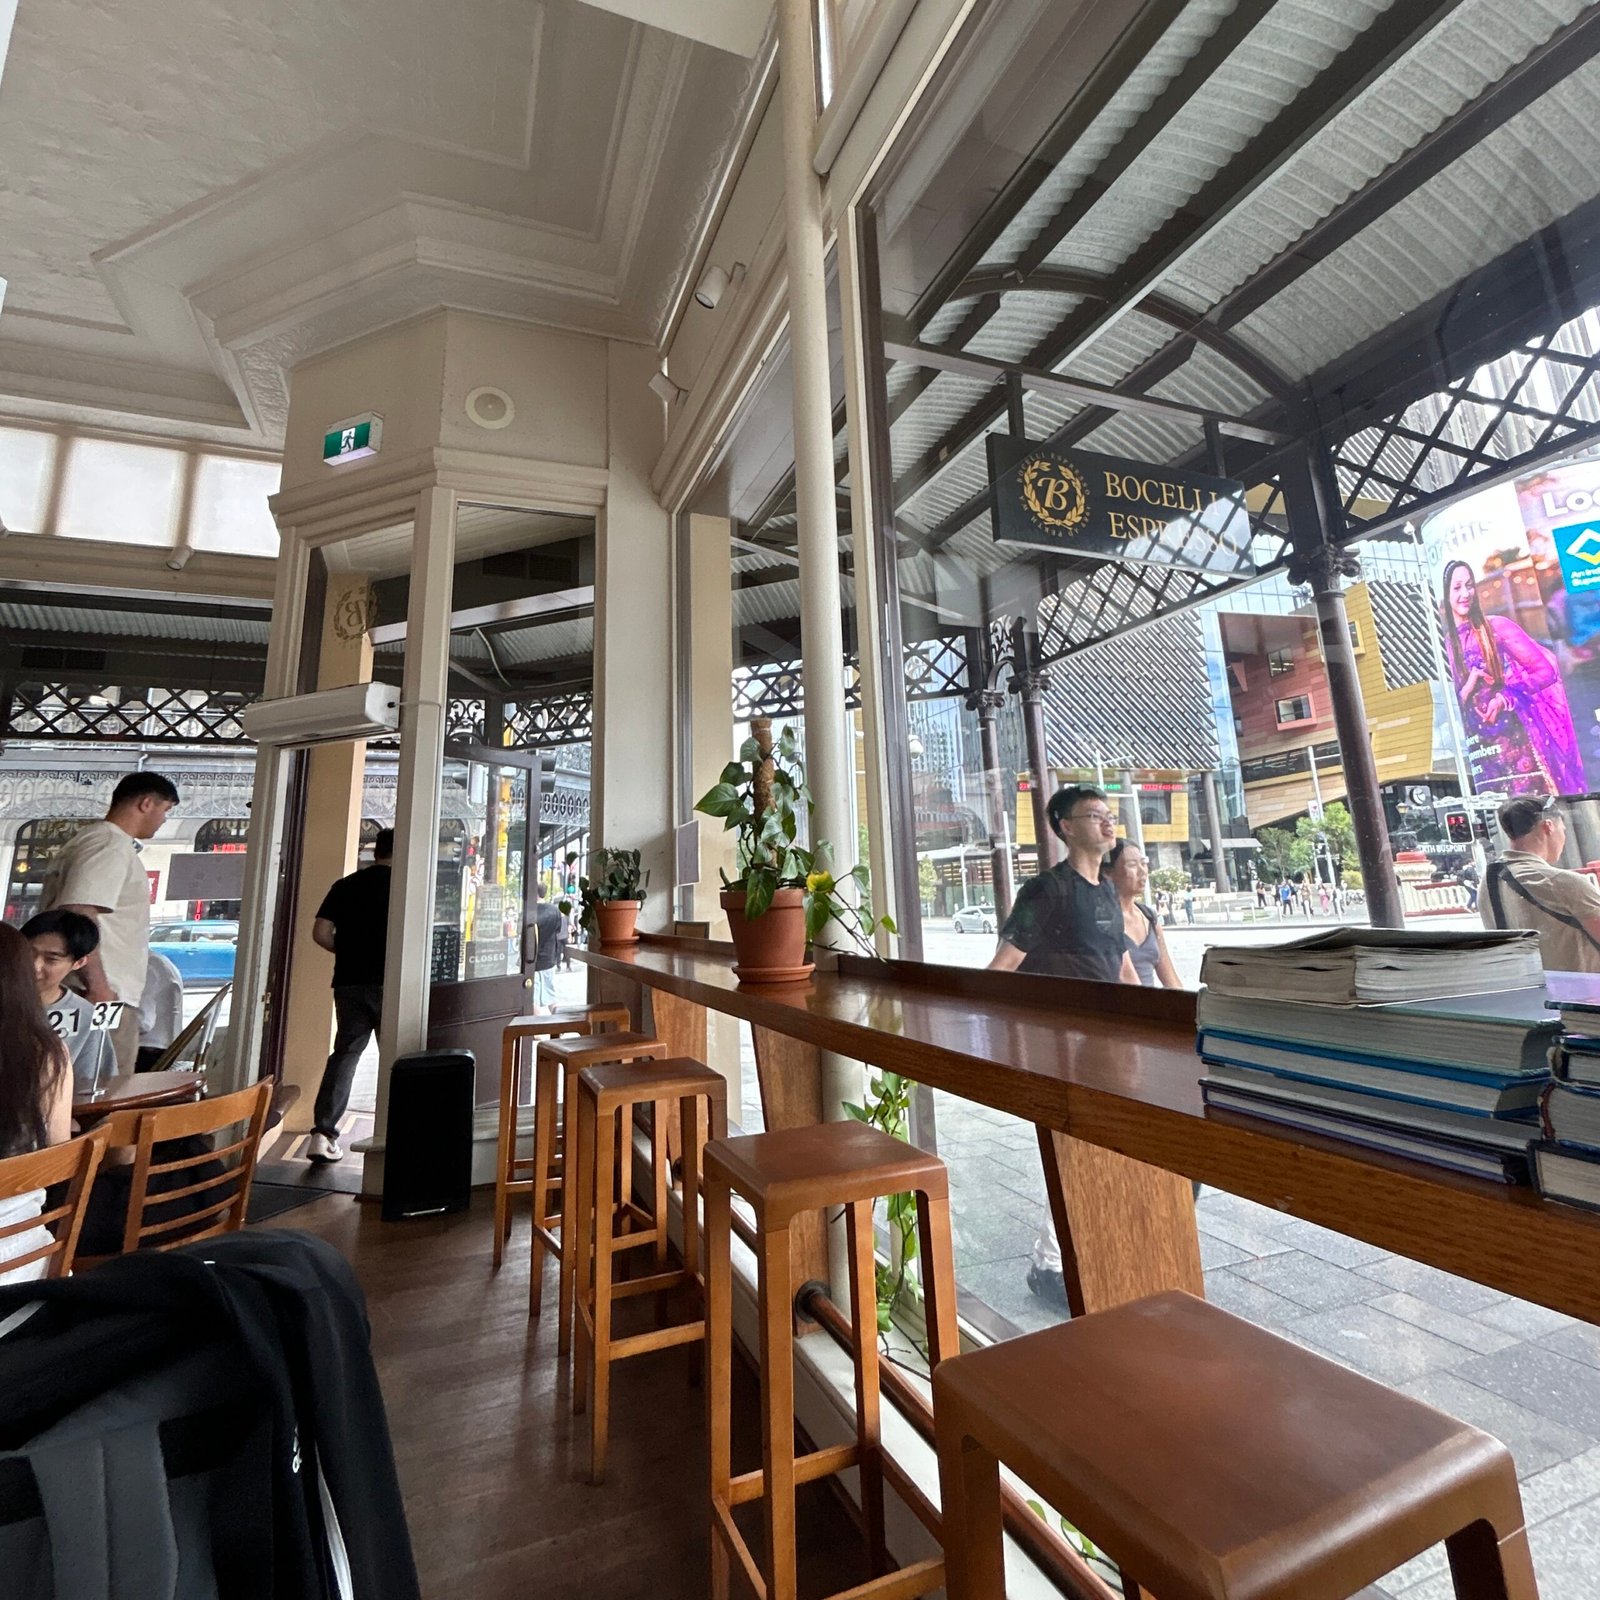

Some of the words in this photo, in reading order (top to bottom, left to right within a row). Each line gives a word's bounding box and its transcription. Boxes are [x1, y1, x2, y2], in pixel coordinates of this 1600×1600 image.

[1037, 477, 1069, 511] B
[1103, 470, 1220, 516] BOCELLI
[469, 952, 506, 964] CLOSED
[47, 1008, 81, 1035] 21
[92, 1002, 124, 1027] 37
